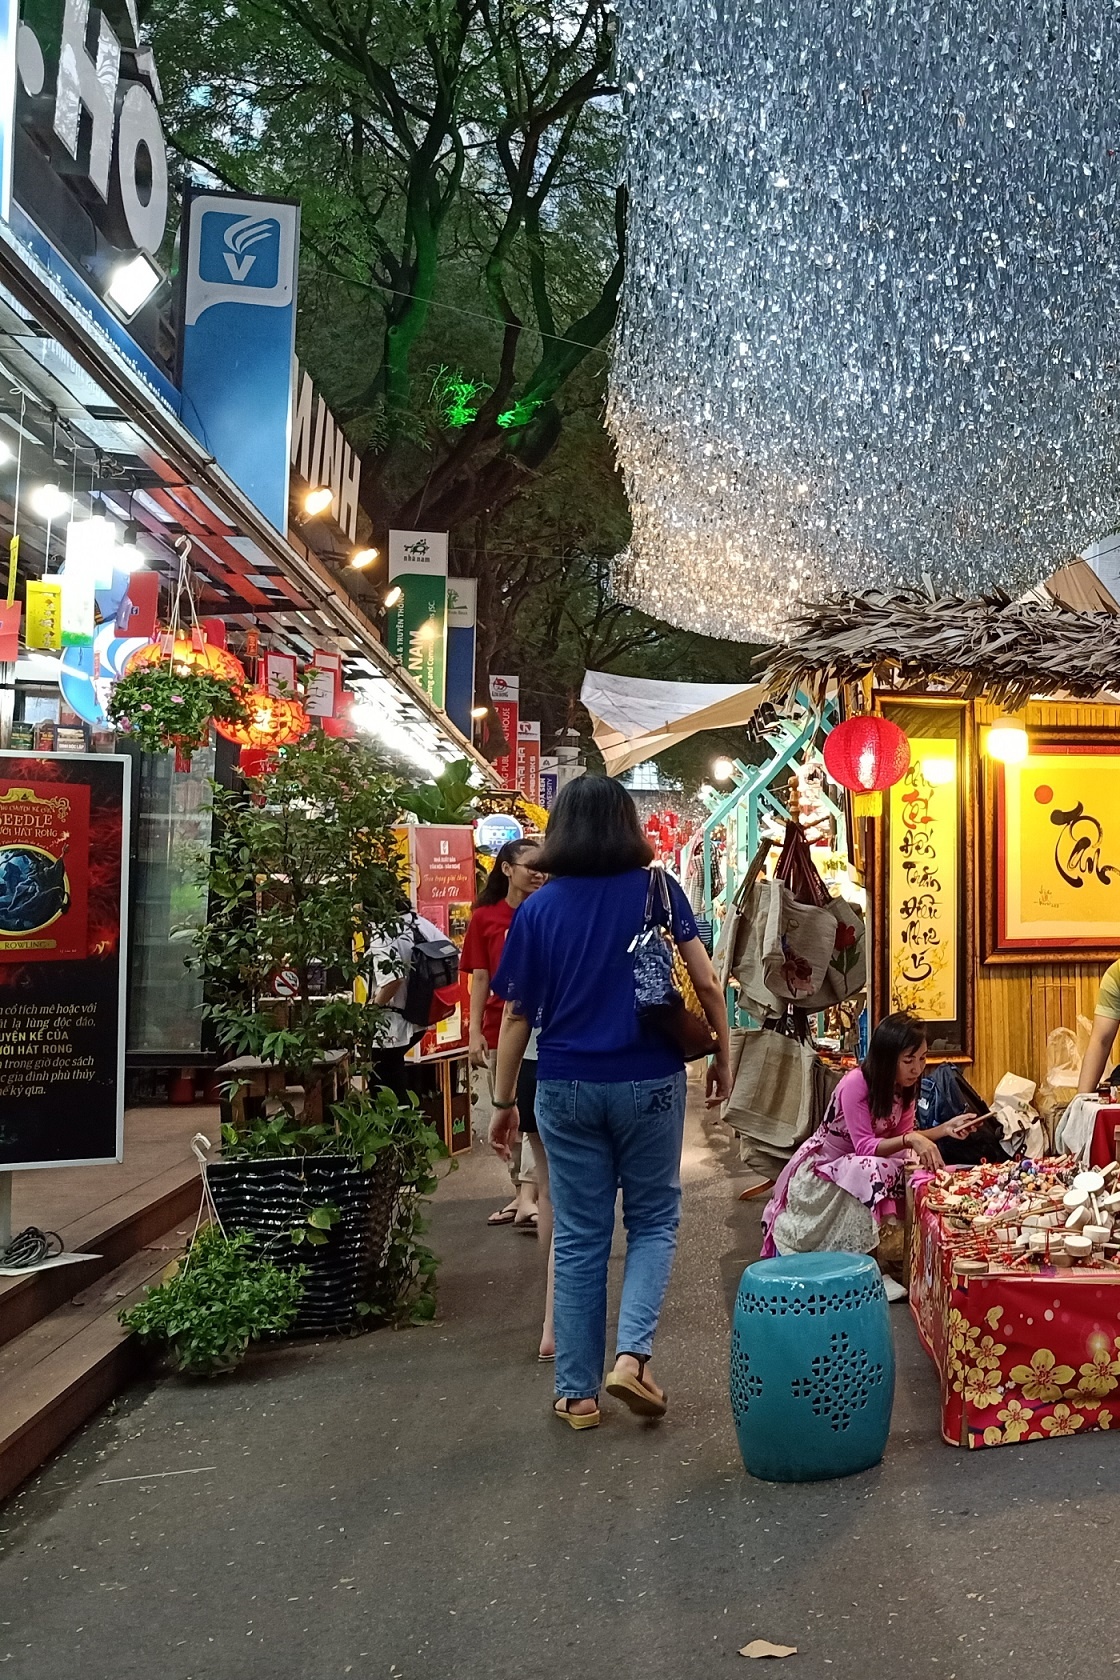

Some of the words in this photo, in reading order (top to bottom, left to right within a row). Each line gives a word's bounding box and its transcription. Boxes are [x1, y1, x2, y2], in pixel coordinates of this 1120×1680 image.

[408, 629, 423, 671] NAM
[502, 707, 511, 731] HOUSE
[0, 813, 53, 828] EEDLE
[35, 828, 58, 839] RONG
[4, 940, 46, 950] ROWLING
[18, 1004, 38, 1015] tích
[40, 1004, 55, 1014] mê
[81, 1002, 97, 1013] với
[26, 1018, 50, 1029] lùng
[17, 1043, 39, 1055] HÁT
[42, 1044, 73, 1054] RONG
[4, 1059, 34, 1071] trong
[71, 1056, 95, 1066] sách
[7, 1071, 24, 1084] gia
[50, 1070, 71, 1083] phù
